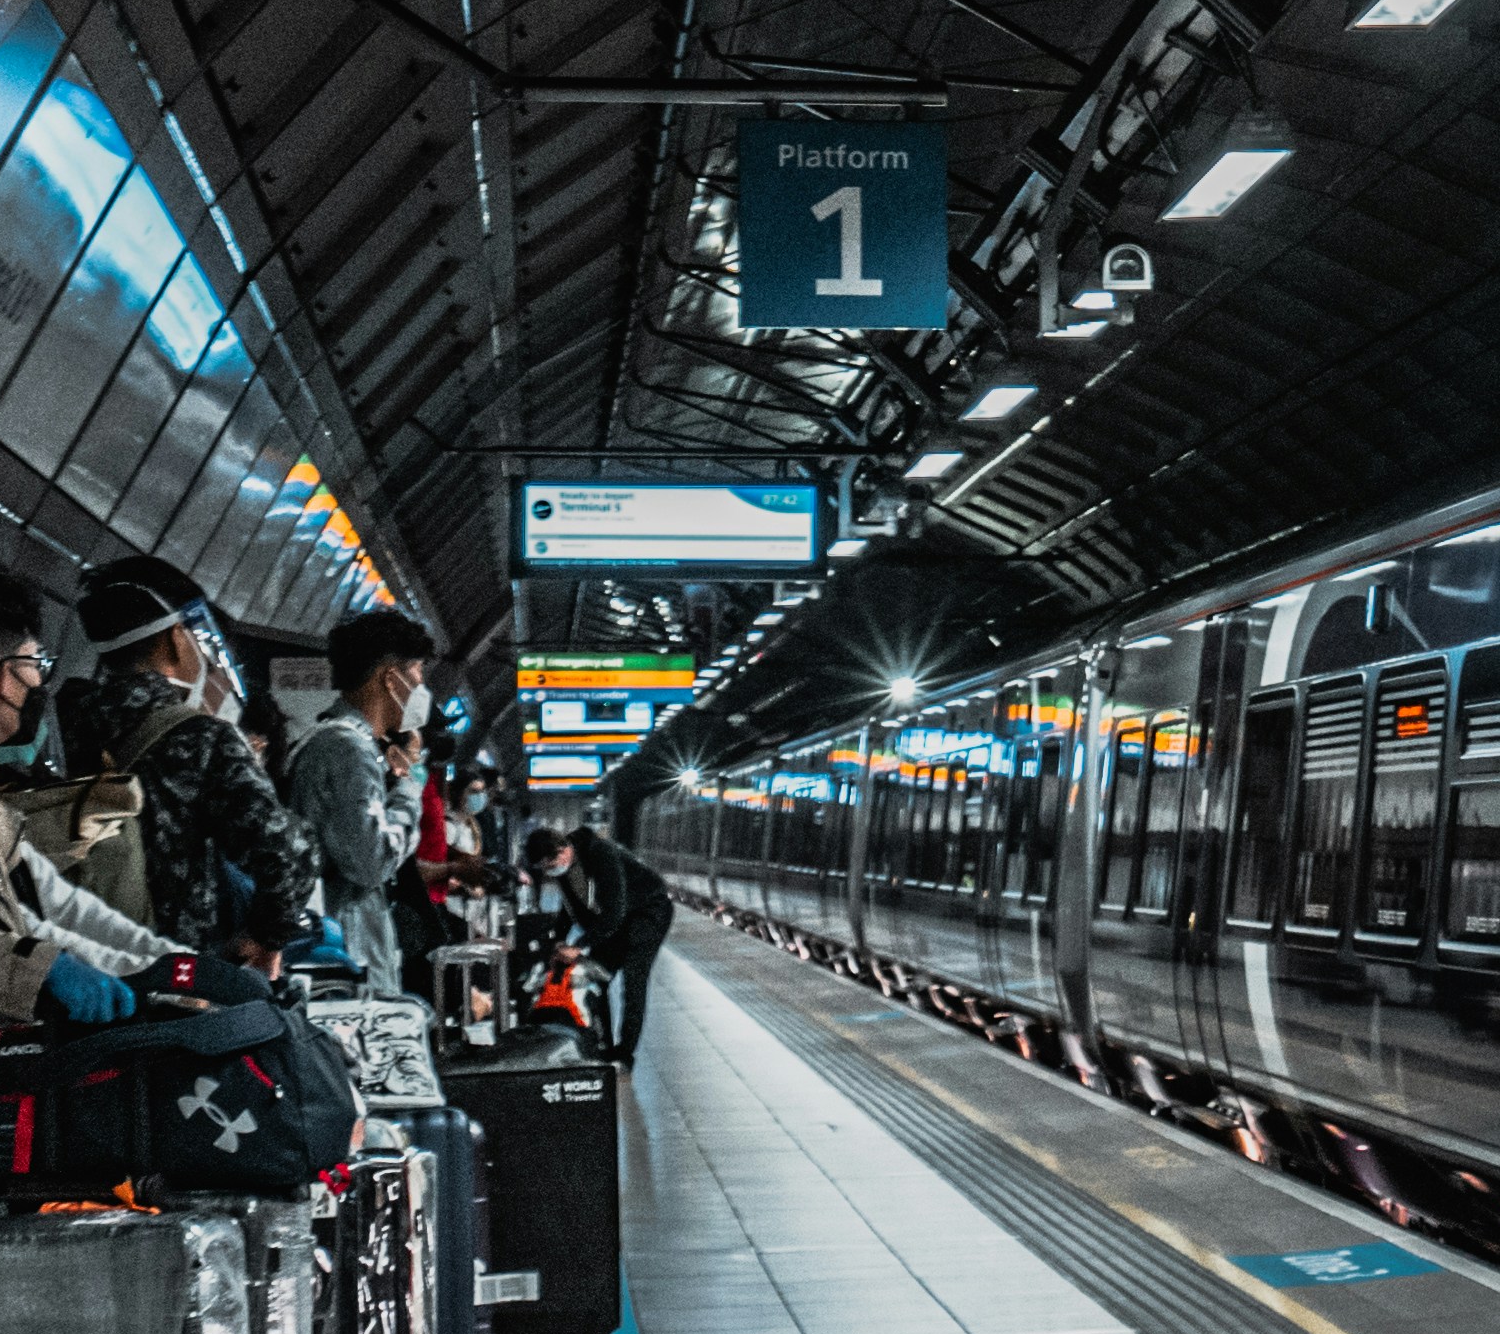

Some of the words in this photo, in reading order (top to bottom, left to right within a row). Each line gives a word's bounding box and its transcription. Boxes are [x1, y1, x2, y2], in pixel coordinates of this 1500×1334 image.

[778, 143, 909, 170] Platform
[809, 185, 884, 297] 1
[560, 502, 611, 512] Terminal
